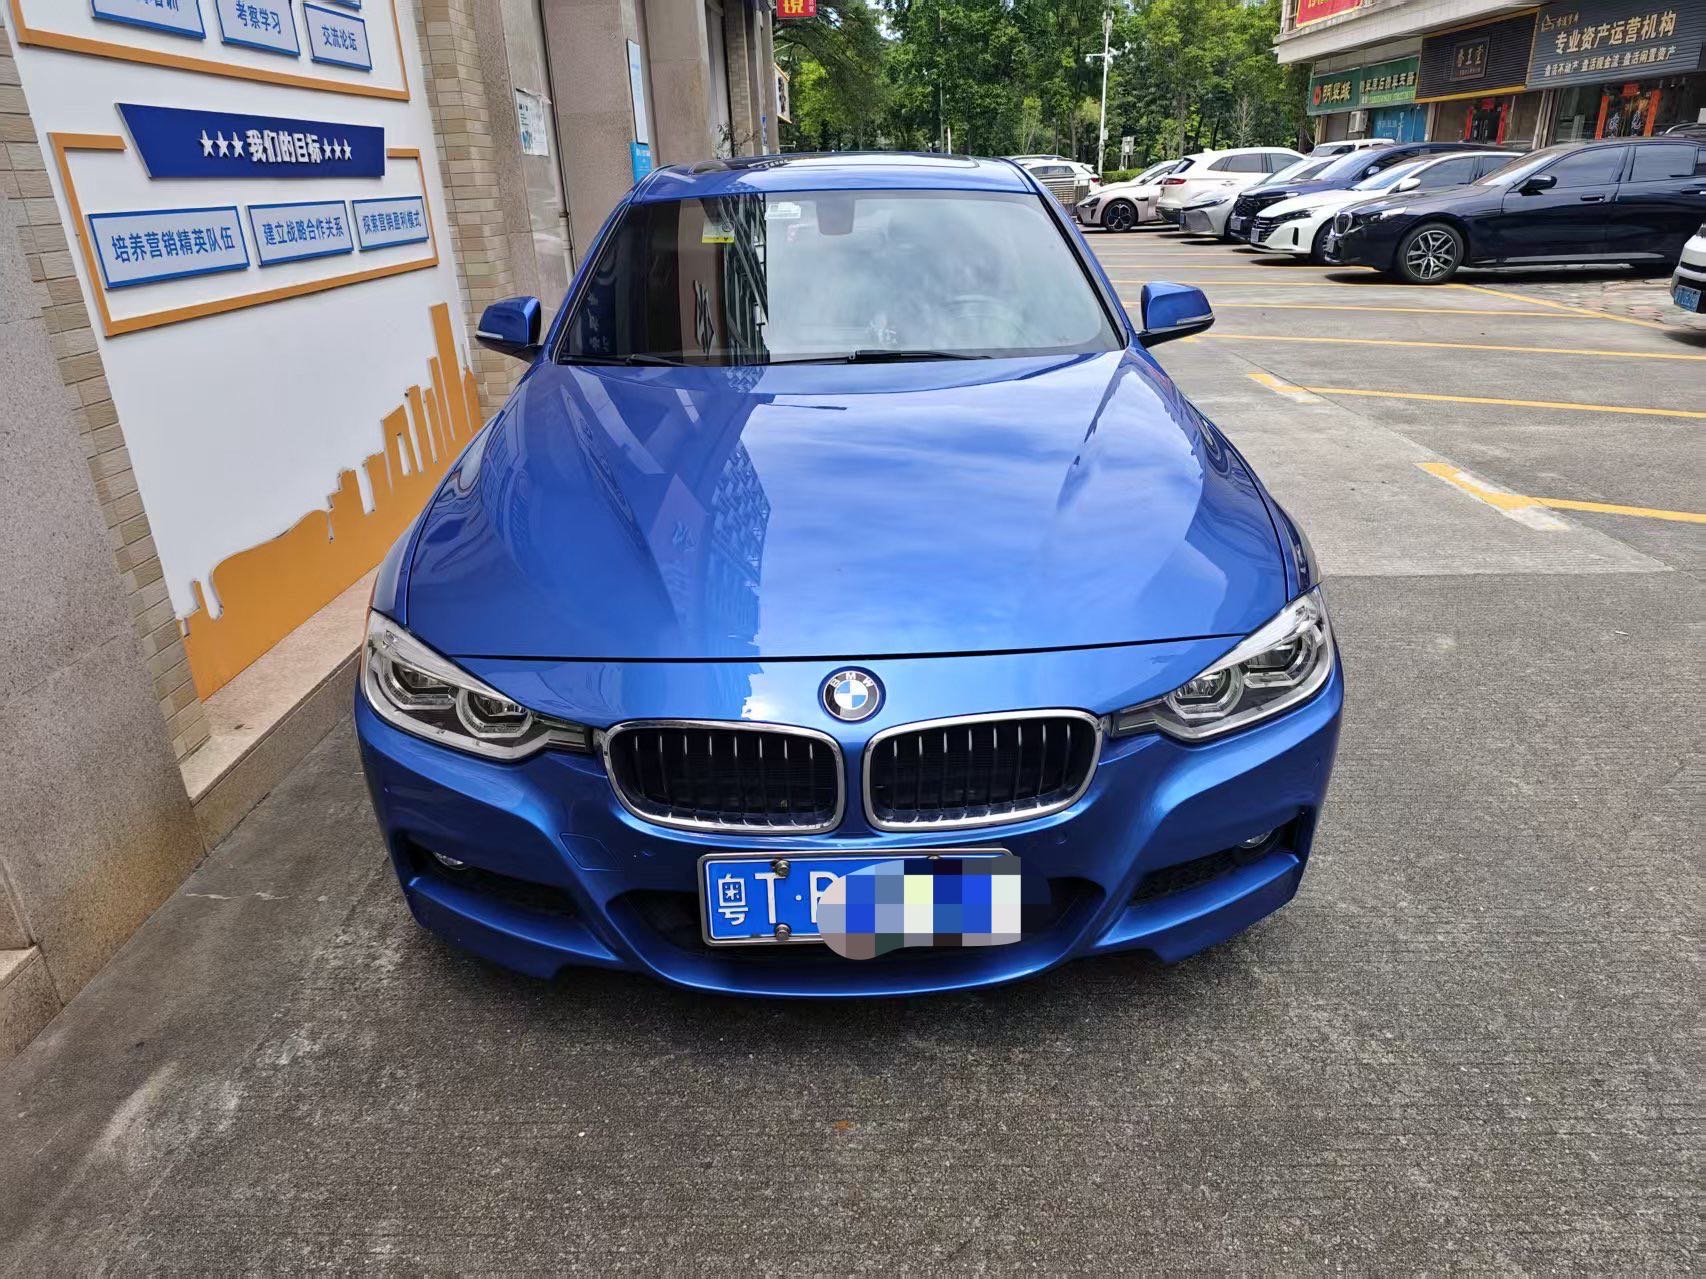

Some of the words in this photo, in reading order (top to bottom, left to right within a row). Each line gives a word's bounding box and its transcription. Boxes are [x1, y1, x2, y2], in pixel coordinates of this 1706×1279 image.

[235, 1, 282, 34] 考察学习
[1555, 10, 1677, 54] 专业资产运营机构
[321, 24, 358, 51] 交流论坛
[246, 129, 322, 163] 我们的目标
[262, 216, 345, 246] 建立战略合作关系
[362, 208, 422, 235] 探索营销盈利模式
[111, 226, 236, 263] 培养营销精英队伍
[829, 672, 875, 688] BMW
